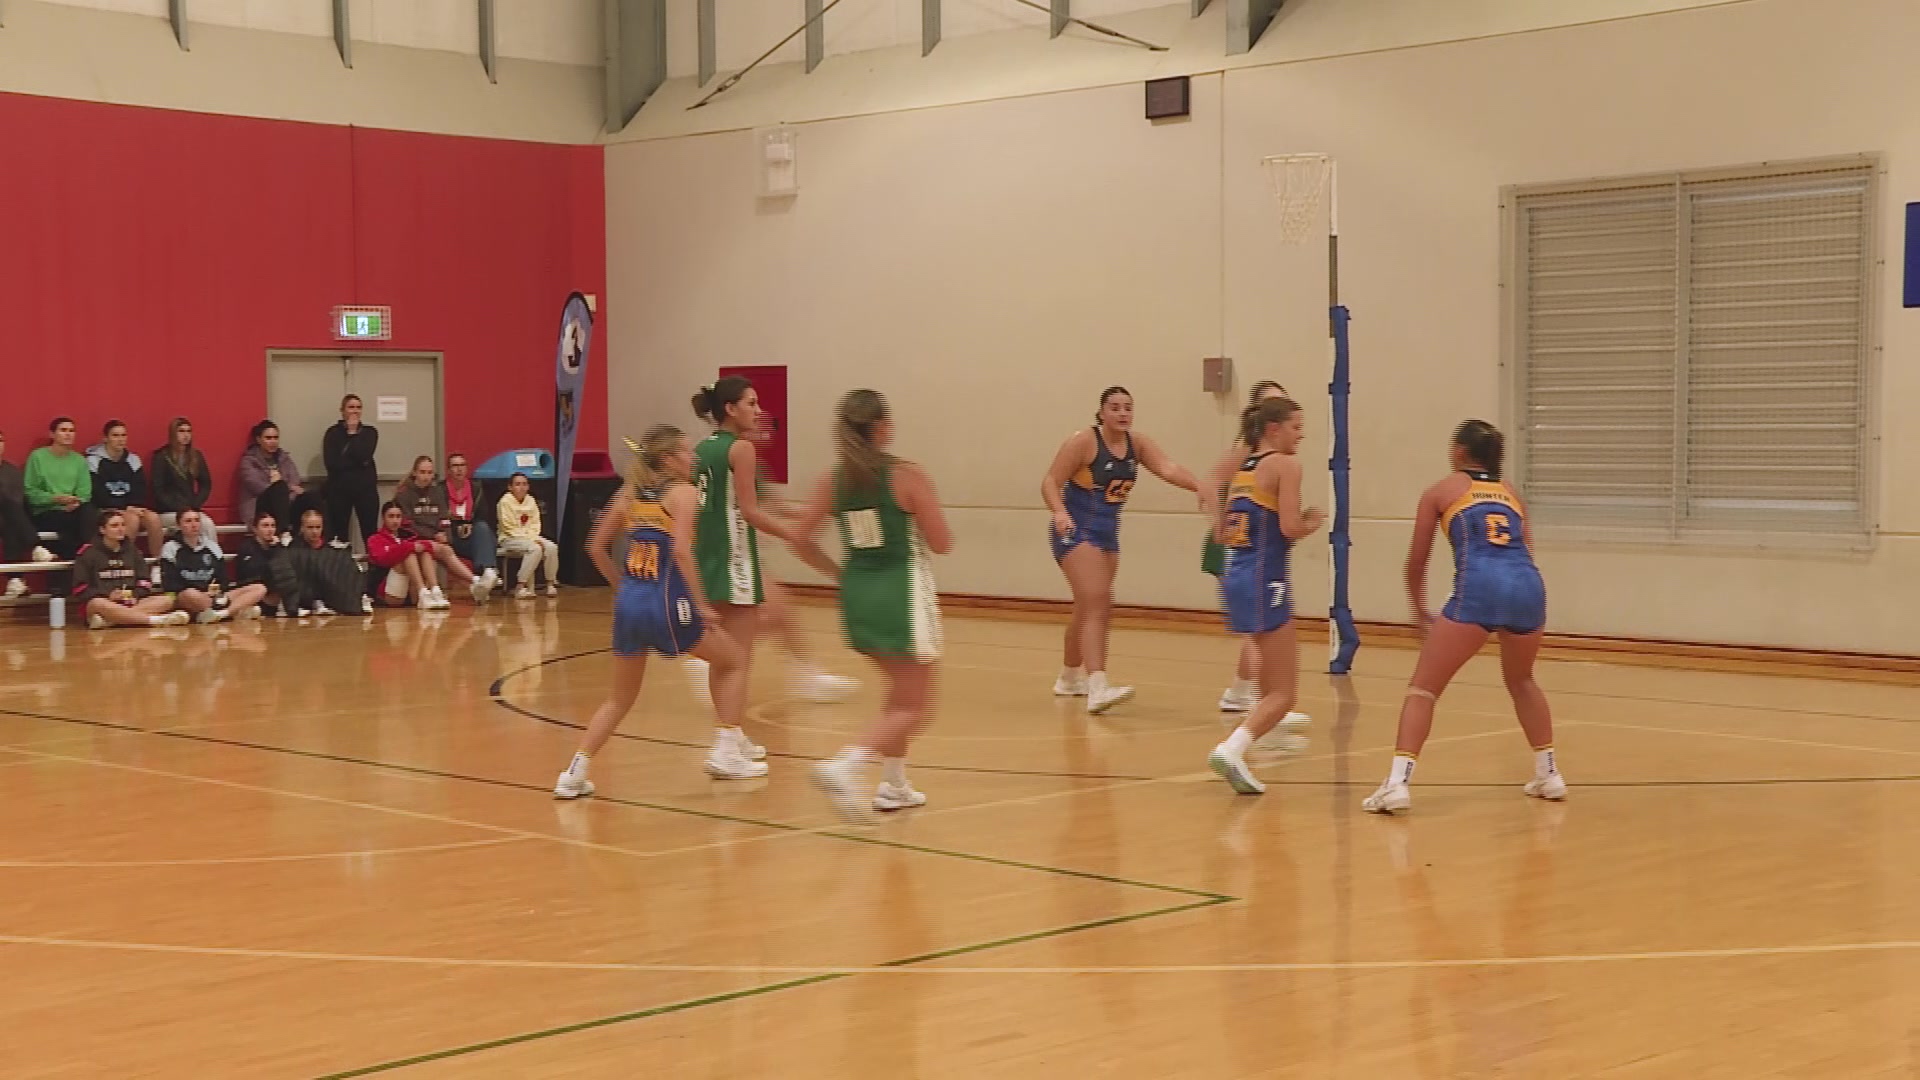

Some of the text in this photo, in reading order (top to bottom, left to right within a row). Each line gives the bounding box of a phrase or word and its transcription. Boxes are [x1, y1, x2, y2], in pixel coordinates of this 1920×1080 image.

[1471, 492, 1511, 503] HUNTER
[1485, 513, 1511, 546] C
[626, 539, 660, 581] WA
[1267, 581, 1286, 608] 7
